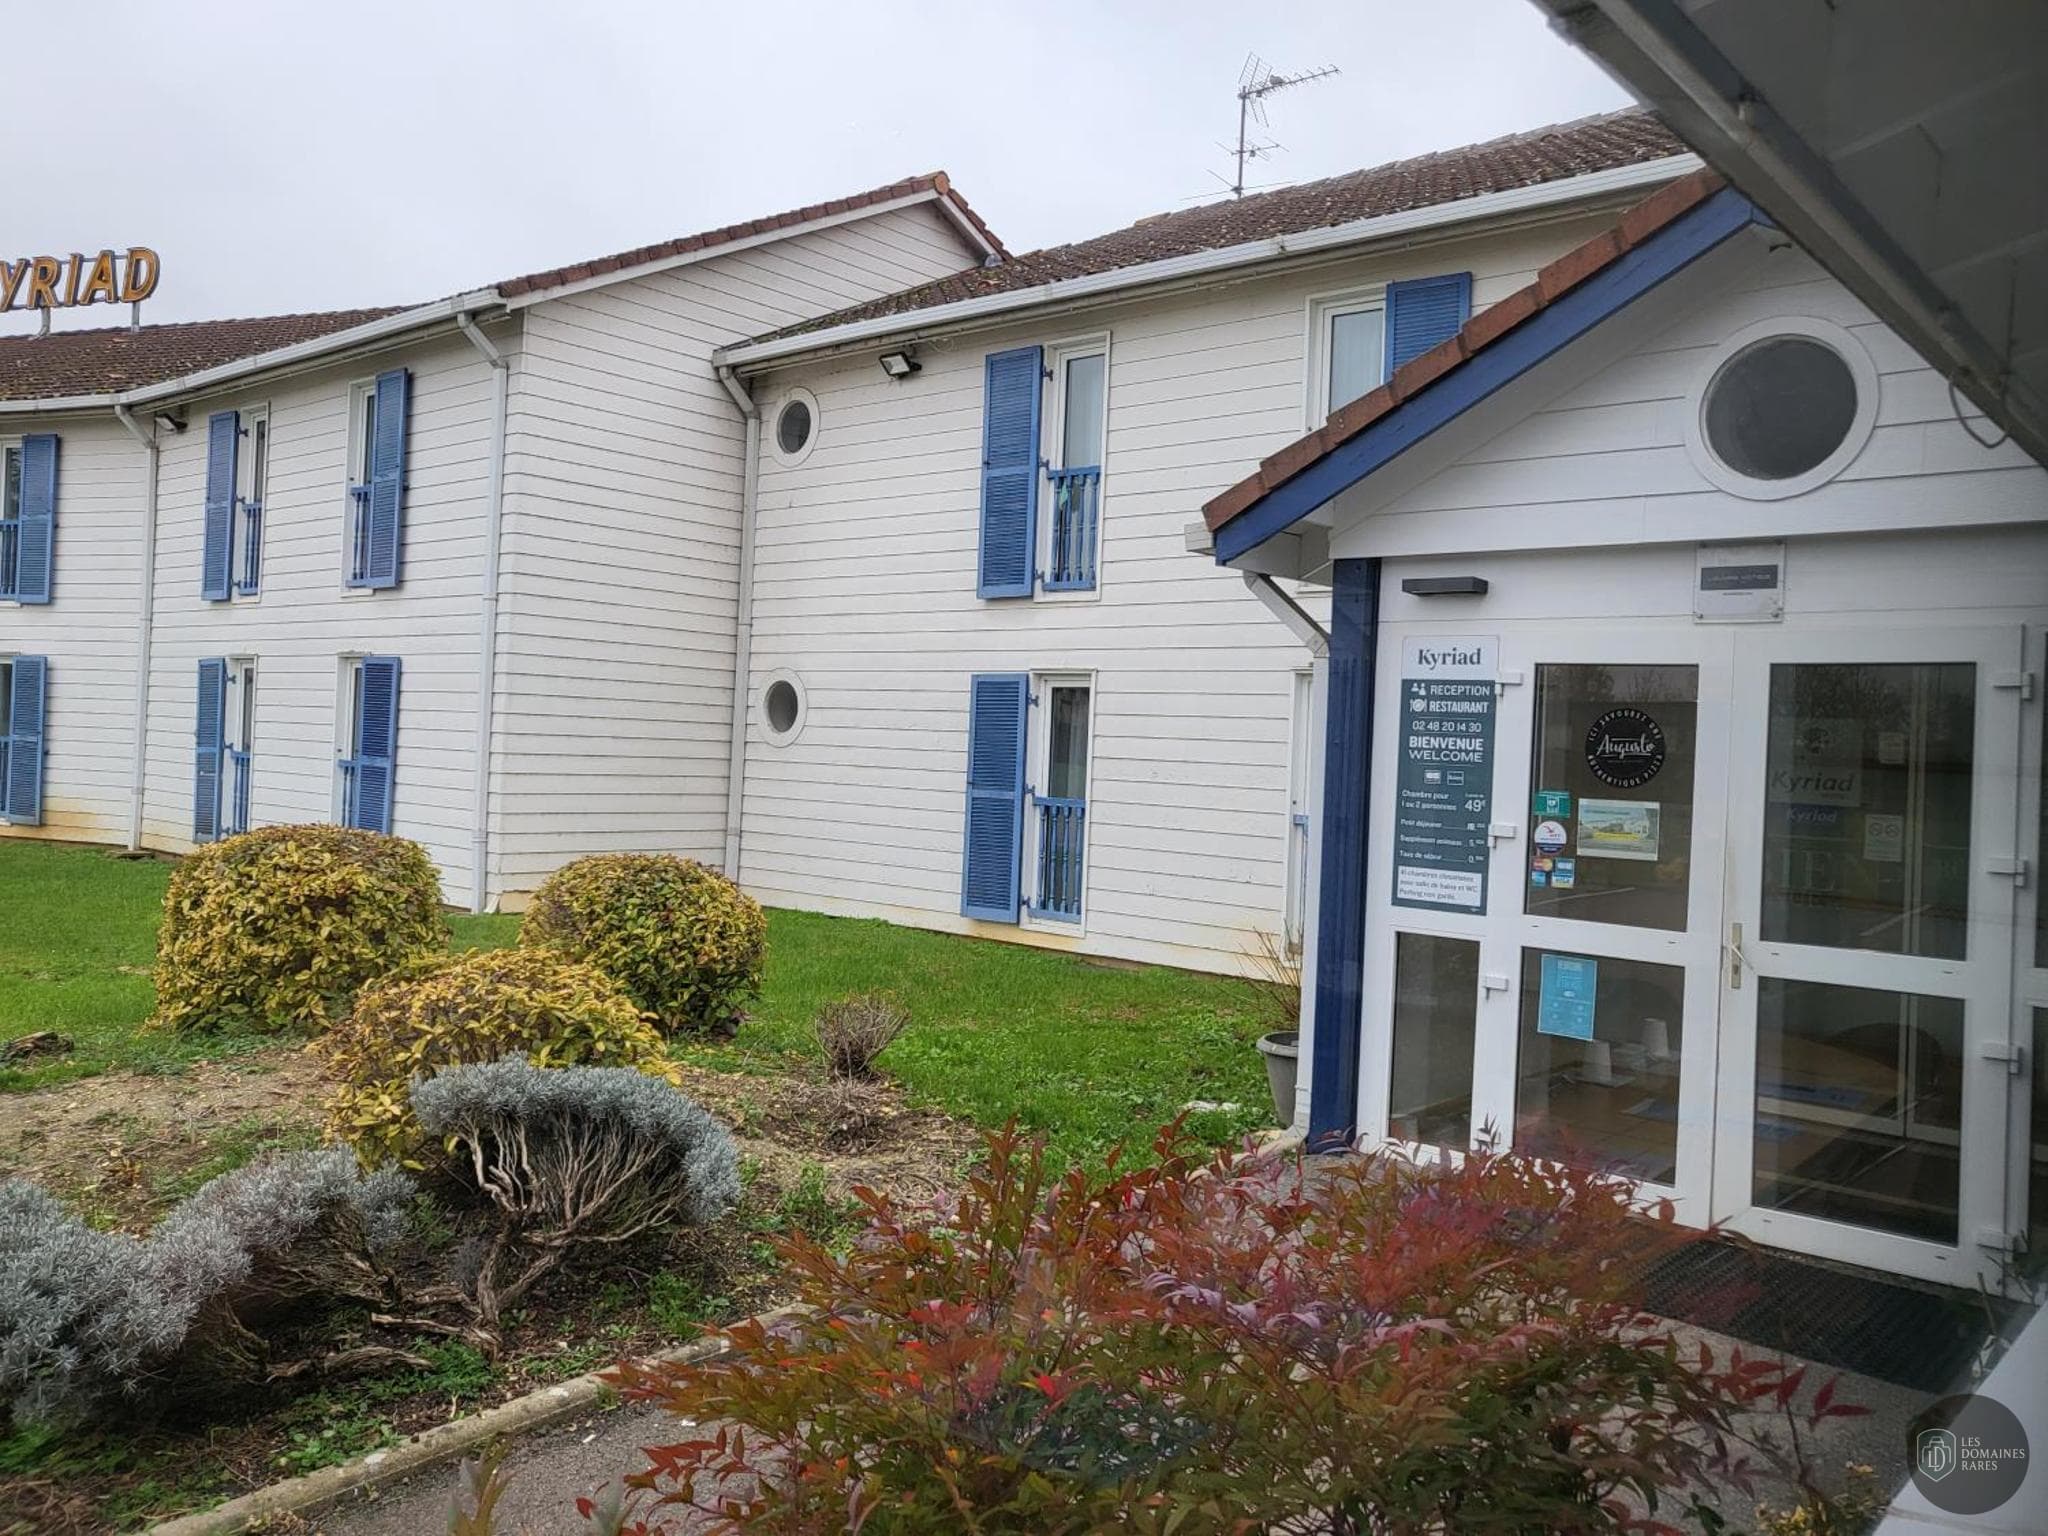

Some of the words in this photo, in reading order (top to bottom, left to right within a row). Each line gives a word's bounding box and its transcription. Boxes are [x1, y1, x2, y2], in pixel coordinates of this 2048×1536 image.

[0, 247, 160, 312] YRIAD
[1418, 647, 1481, 670] Kyriad
[1430, 685, 1490, 696] RECEPTION
[1429, 701, 1489, 713] RESTAURANT
[1412, 720, 1425, 731] 02
[1426, 721, 1440, 731] 48
[1441, 721, 1455, 732] 20
[1457, 722, 1466, 732] 14
[1468, 722, 1482, 733] 30
[1409, 736, 1484, 751] BIENVENUE
[1596, 733, 1656, 760] Augusto
[1409, 750, 1483, 763] WELCOME
[1771, 770, 1854, 793] Kyriad
[1402, 789, 1432, 799] Chambre
[1433, 792, 1449, 800] pour
